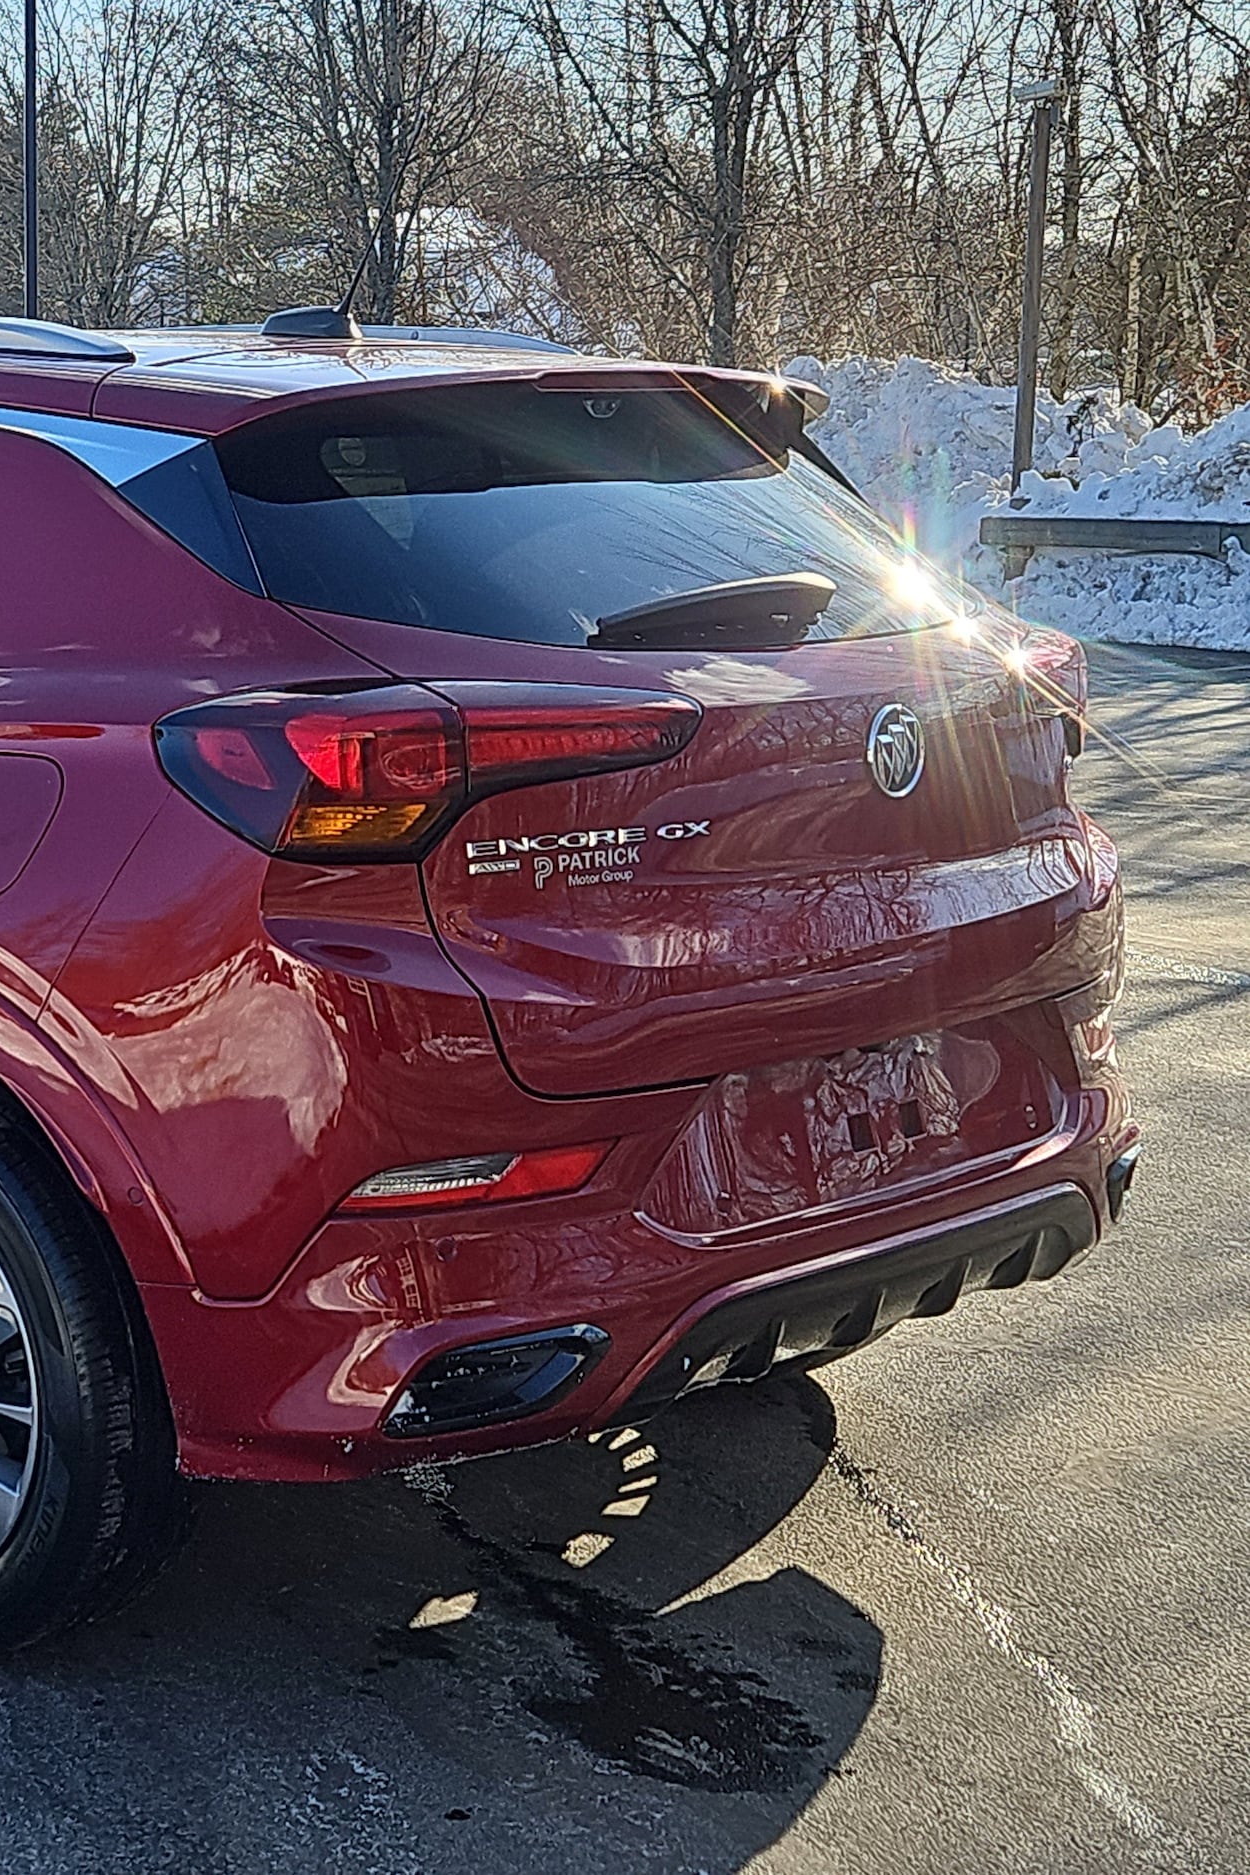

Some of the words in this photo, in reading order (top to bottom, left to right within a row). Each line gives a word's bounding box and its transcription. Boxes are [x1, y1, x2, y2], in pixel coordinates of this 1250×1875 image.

[466, 827, 646, 858] ENCORE
[656, 820, 711, 839] GX
[468, 859, 520, 875] AWD
[557, 846, 640, 872] PATRICK
[567, 873, 600, 887] Motor
[601, 869, 634, 883] Group
